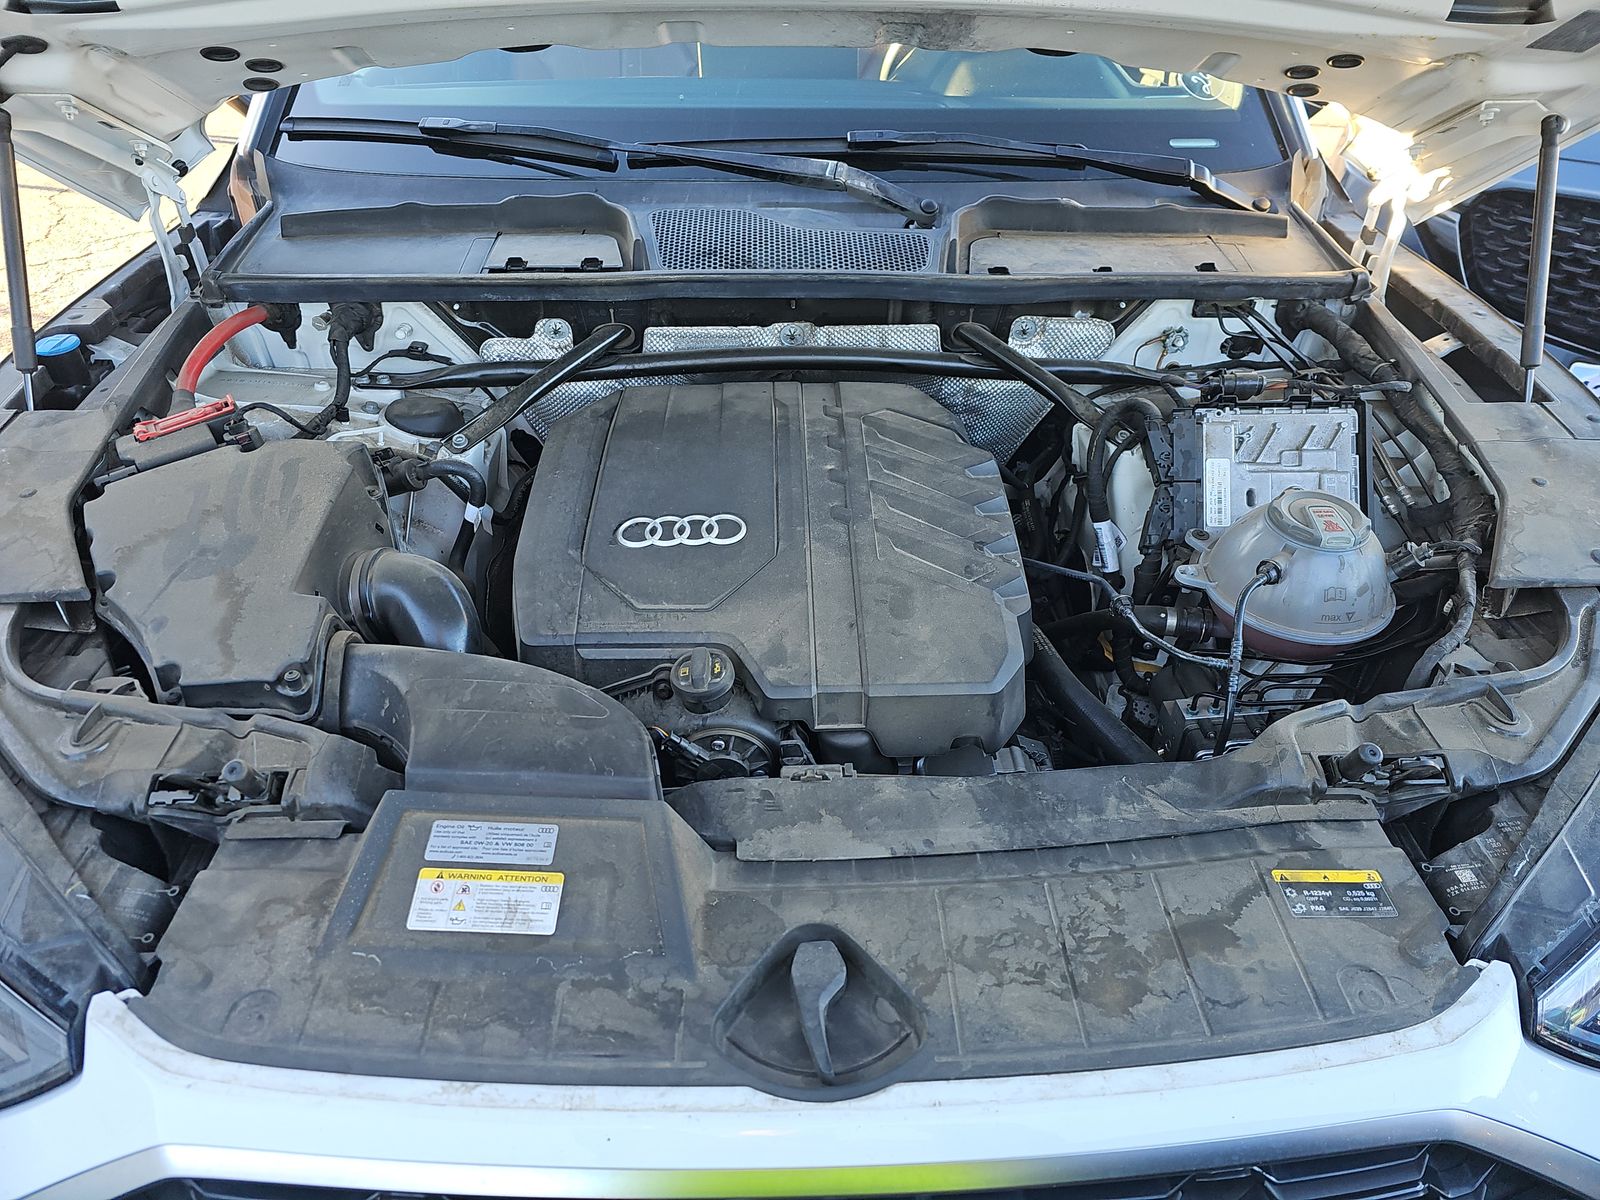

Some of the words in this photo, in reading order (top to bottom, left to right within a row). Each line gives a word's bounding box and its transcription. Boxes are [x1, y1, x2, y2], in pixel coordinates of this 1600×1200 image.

[1321, 613, 1342, 622] max
[448, 872, 493, 881] WARNING
[497, 874, 549, 883] ATTENTION
[1366, 890, 1376, 898] kg
